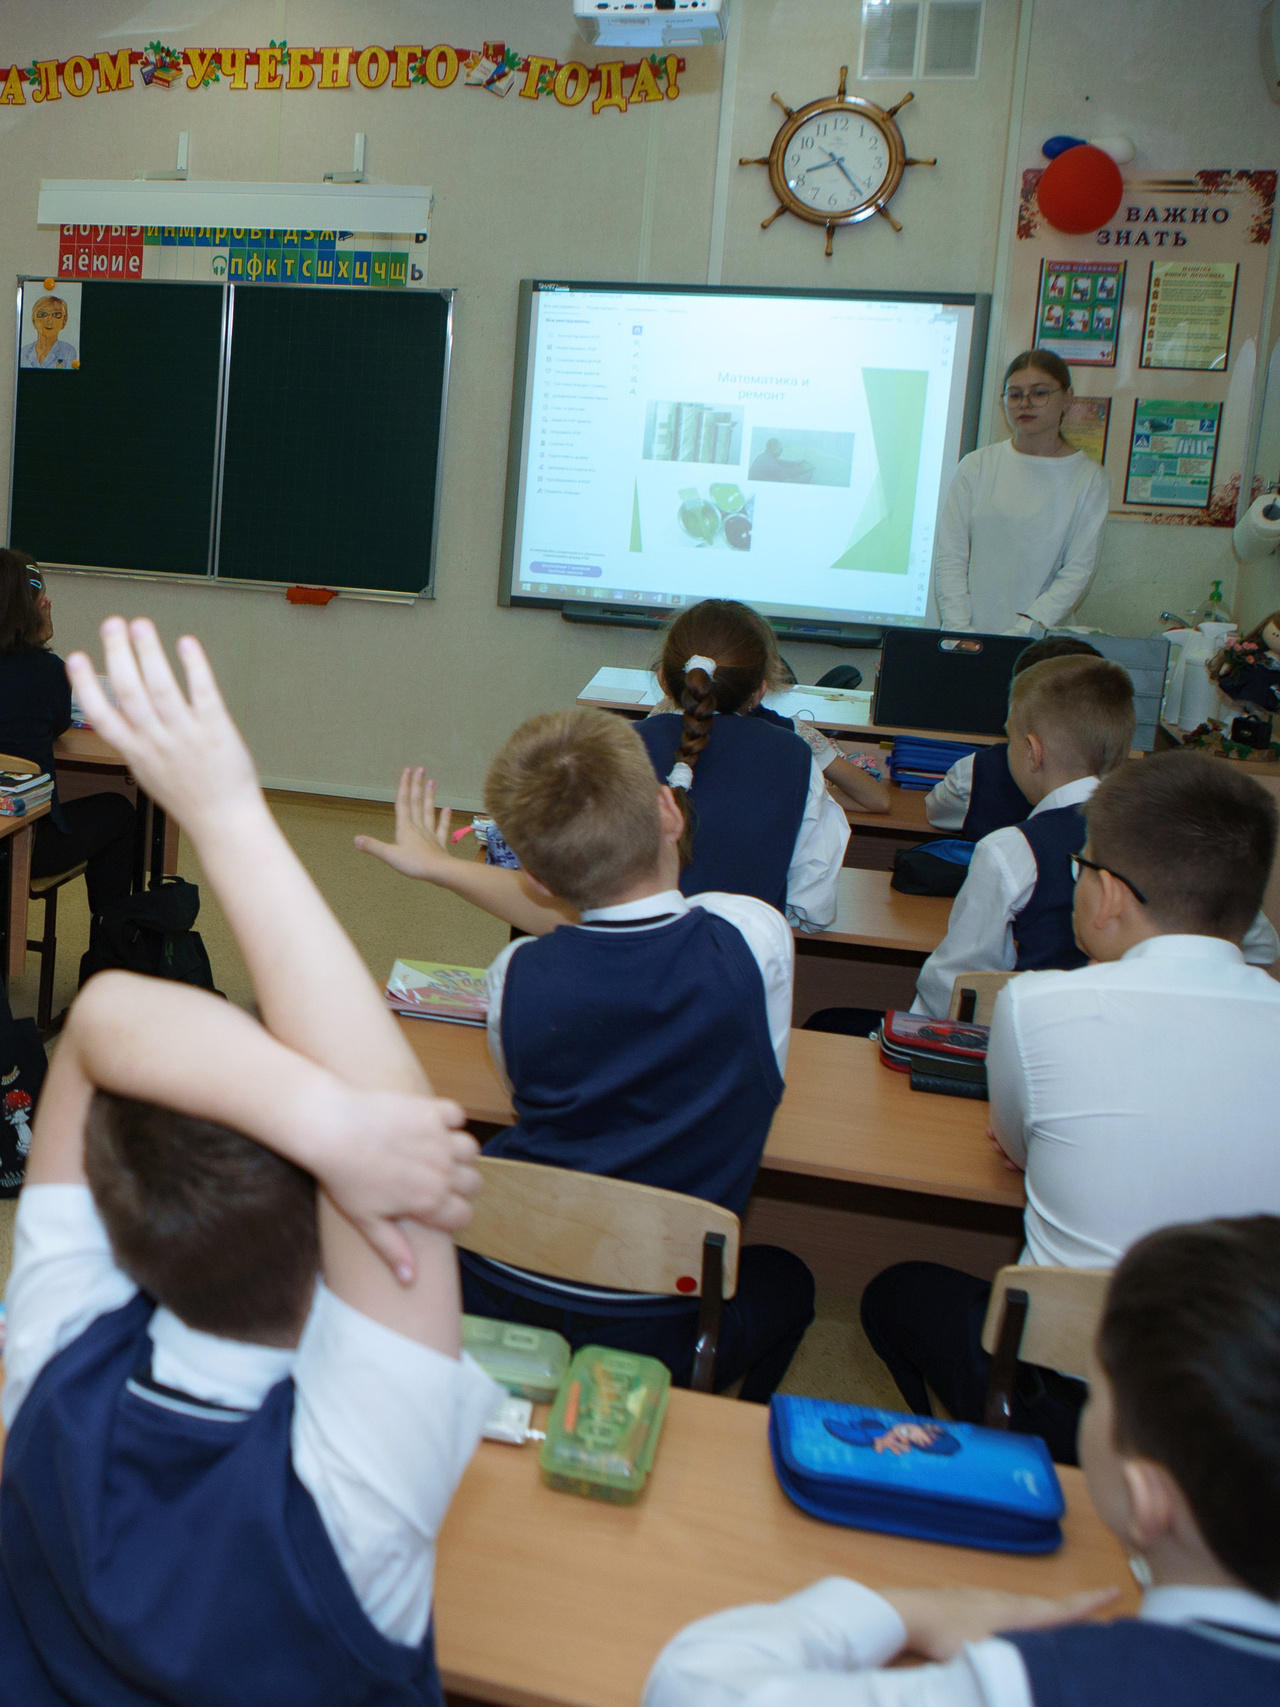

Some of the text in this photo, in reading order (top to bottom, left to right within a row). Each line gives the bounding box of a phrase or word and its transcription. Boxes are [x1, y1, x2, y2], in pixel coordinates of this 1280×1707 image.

[183, 43, 460, 92] УЧЕБНОГО
[519, 52, 683, 115] ГОДА!
[816, 123, 828, 137] 11
[833, 117, 849, 131] 12
[859, 124, 865, 138] 1
[800, 136, 815, 150] 10
[868, 136, 878, 150] 2
[791, 153, 801, 168] 9
[873, 156, 883, 170] 3
[796, 174, 806, 187] 8
[862, 175, 873, 188] 4
[811, 187, 820, 200] 7
[828, 193, 837, 206] 6
[1125, 207, 1230, 224] ВАЖНО
[1096, 230, 1188, 247] ЗНАТЬ
[717, 371, 810, 387] Математика и
[738, 389, 786, 401] ремонт
